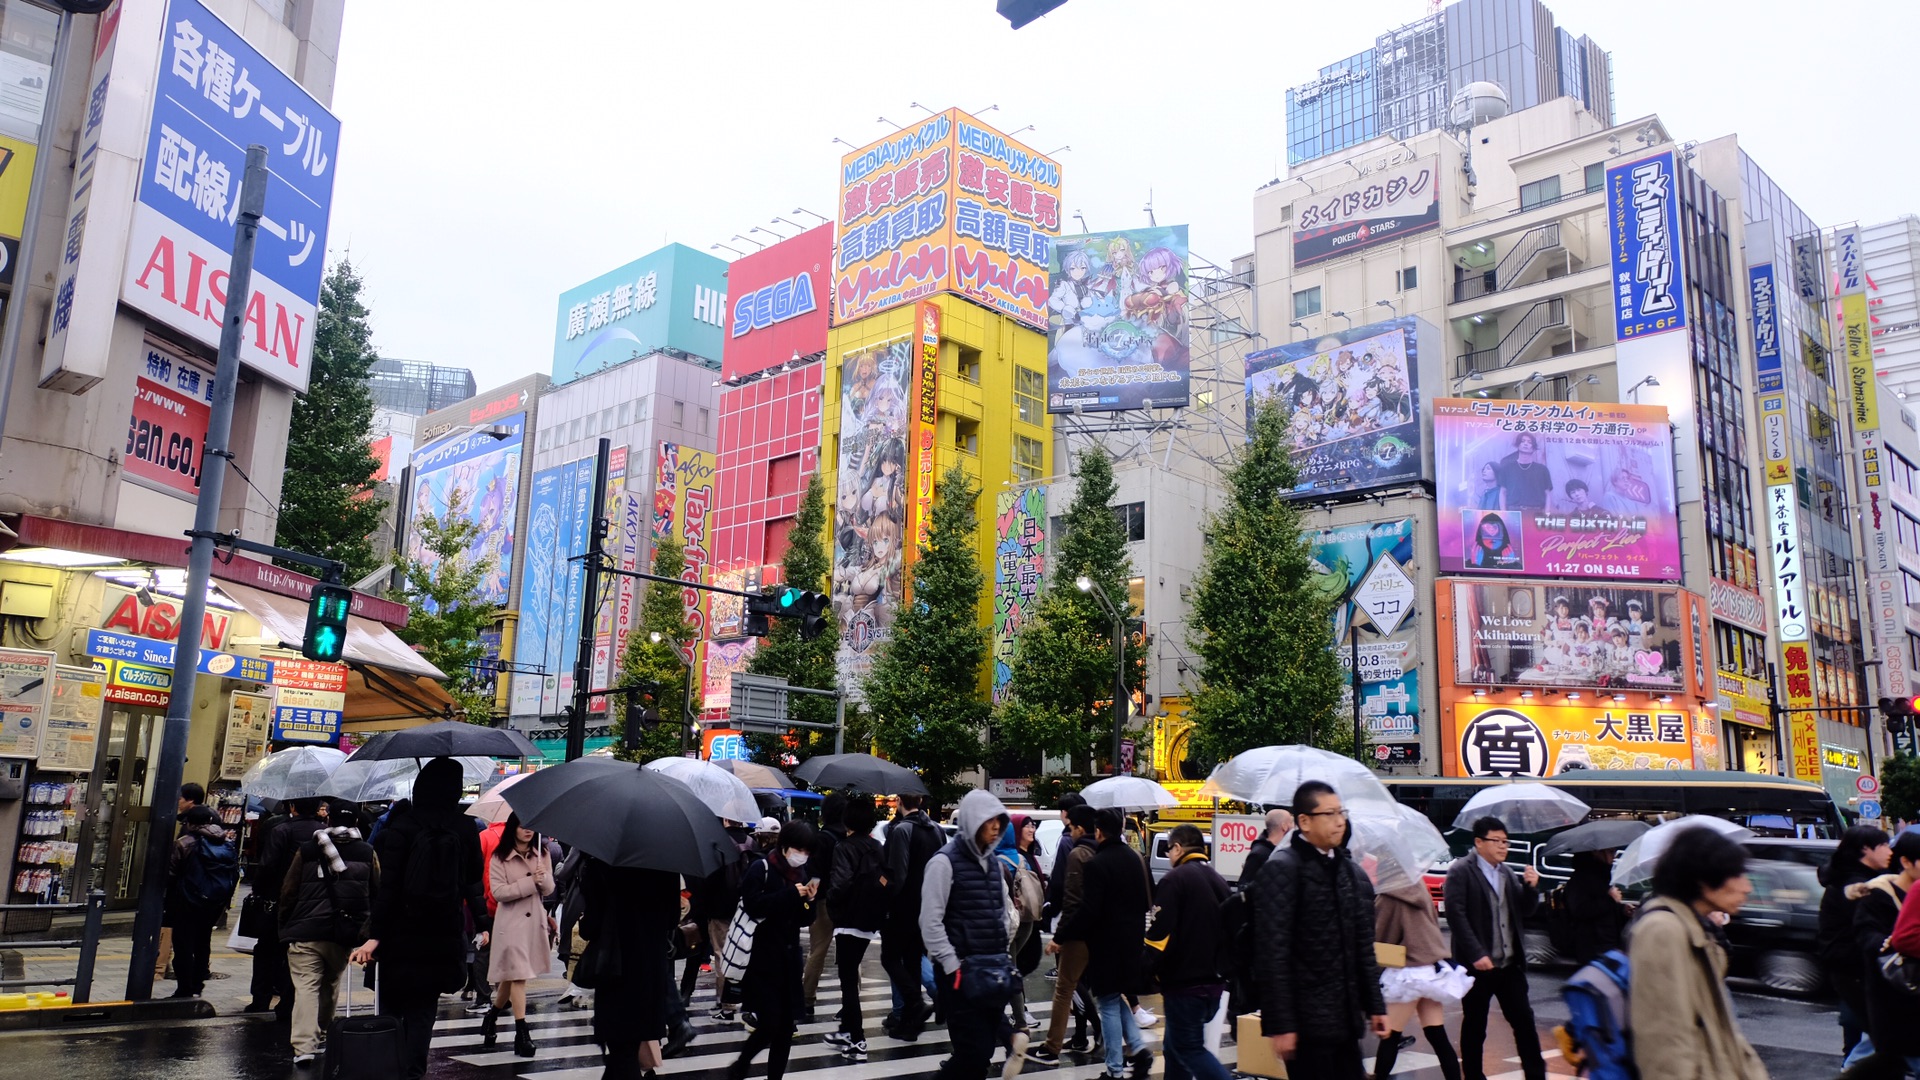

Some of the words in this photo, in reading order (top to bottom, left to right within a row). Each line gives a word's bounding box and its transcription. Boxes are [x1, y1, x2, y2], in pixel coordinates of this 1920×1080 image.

[173, 19, 328, 177] 各種ケーブル
[843, 114, 951, 186] MEDIAリサイクル
[958, 122, 1059, 187] MEDIAリサイクル
[843, 148, 950, 225] 激安販売
[958, 152, 1058, 230] 激安販売
[1301, 170, 1430, 229] メイドカジノ
[839, 191, 946, 270] 高額買取
[954, 198, 1050, 267] 高額買取
[1332, 229, 1356, 246] POKER
[1370, 220, 1395, 234] STARS
[1615, 181, 1628, 258] トレーディングカードゲーム
[1632, 161, 1676, 315] アメニティドリーム
[1841, 233, 1859, 289] スーパービル
[838, 245, 948, 318] Mulan
[847, 300, 877, 319] ムーラン
[878, 293, 902, 308] AKIBA
[902, 282, 937, 299] 中央通り店
[964, 286, 997, 305] ムーラン
[996, 298, 1020, 315] AKIBA
[1619, 272, 1632, 320] 秋葉原店
[135, 235, 305, 368] AISAN
[732, 271, 817, 339] SEGA
[924, 345, 936, 355] DVD
[1848, 323, 1862, 358] Yellow
[147, 351, 171, 383] 特約
[177, 365, 200, 396] 在庫
[922, 388, 935, 397] アニメ
[924, 371, 934, 380] CD
[469, 393, 519, 423] ビックカメラ
[1471, 402, 1596, 420] 「ゴールデンカムイ」
[1766, 400, 1780, 410] 3F
[1852, 366, 1868, 424] Submarine
[422, 422, 452, 440] Sofmap
[1495, 420, 1636, 436] 「とある科学の一方通行」
[1769, 417, 1782, 458] りらくる
[1861, 431, 1875, 440] 5F
[626, 495, 639, 545] AKKY
[1535, 517, 1566, 528] THE
[1570, 519, 1618, 528] SIXTH
[1622, 521, 1647, 530] LIE
[1540, 532, 1608, 559] Perfect
[1601, 528, 1642, 551] Lies
[1369, 579, 1404, 592] アトリエ
[1546, 562, 1580, 573] 11.27
[1584, 564, 1603, 574] ON
[1606, 565, 1640, 575] SALE
[103, 594, 228, 650] AISN
[1373, 600, 1400, 616] ココ
[1481, 615, 1501, 627] We
[1502, 616, 1532, 627] Love
[1710, 582, 1764, 625] メイドカジノ
[1880, 580, 1897, 635] amiami
[1473, 629, 1541, 642] Akihabara
[143, 649, 167, 664] Since
[1785, 646, 1811, 698] 免税
[1887, 646, 1905, 695] あみあみ
[280, 708, 338, 725] 愛三電機
[1553, 730, 1590, 741] チケット
[1595, 712, 1686, 744] 大黒屋
[1803, 702, 1814, 732] TAX
[1472, 722, 1537, 778] 質
[1807, 737, 1820, 776] FREE
[1861, 780, 1873, 789] 40
[1863, 805, 1872, 817] P
